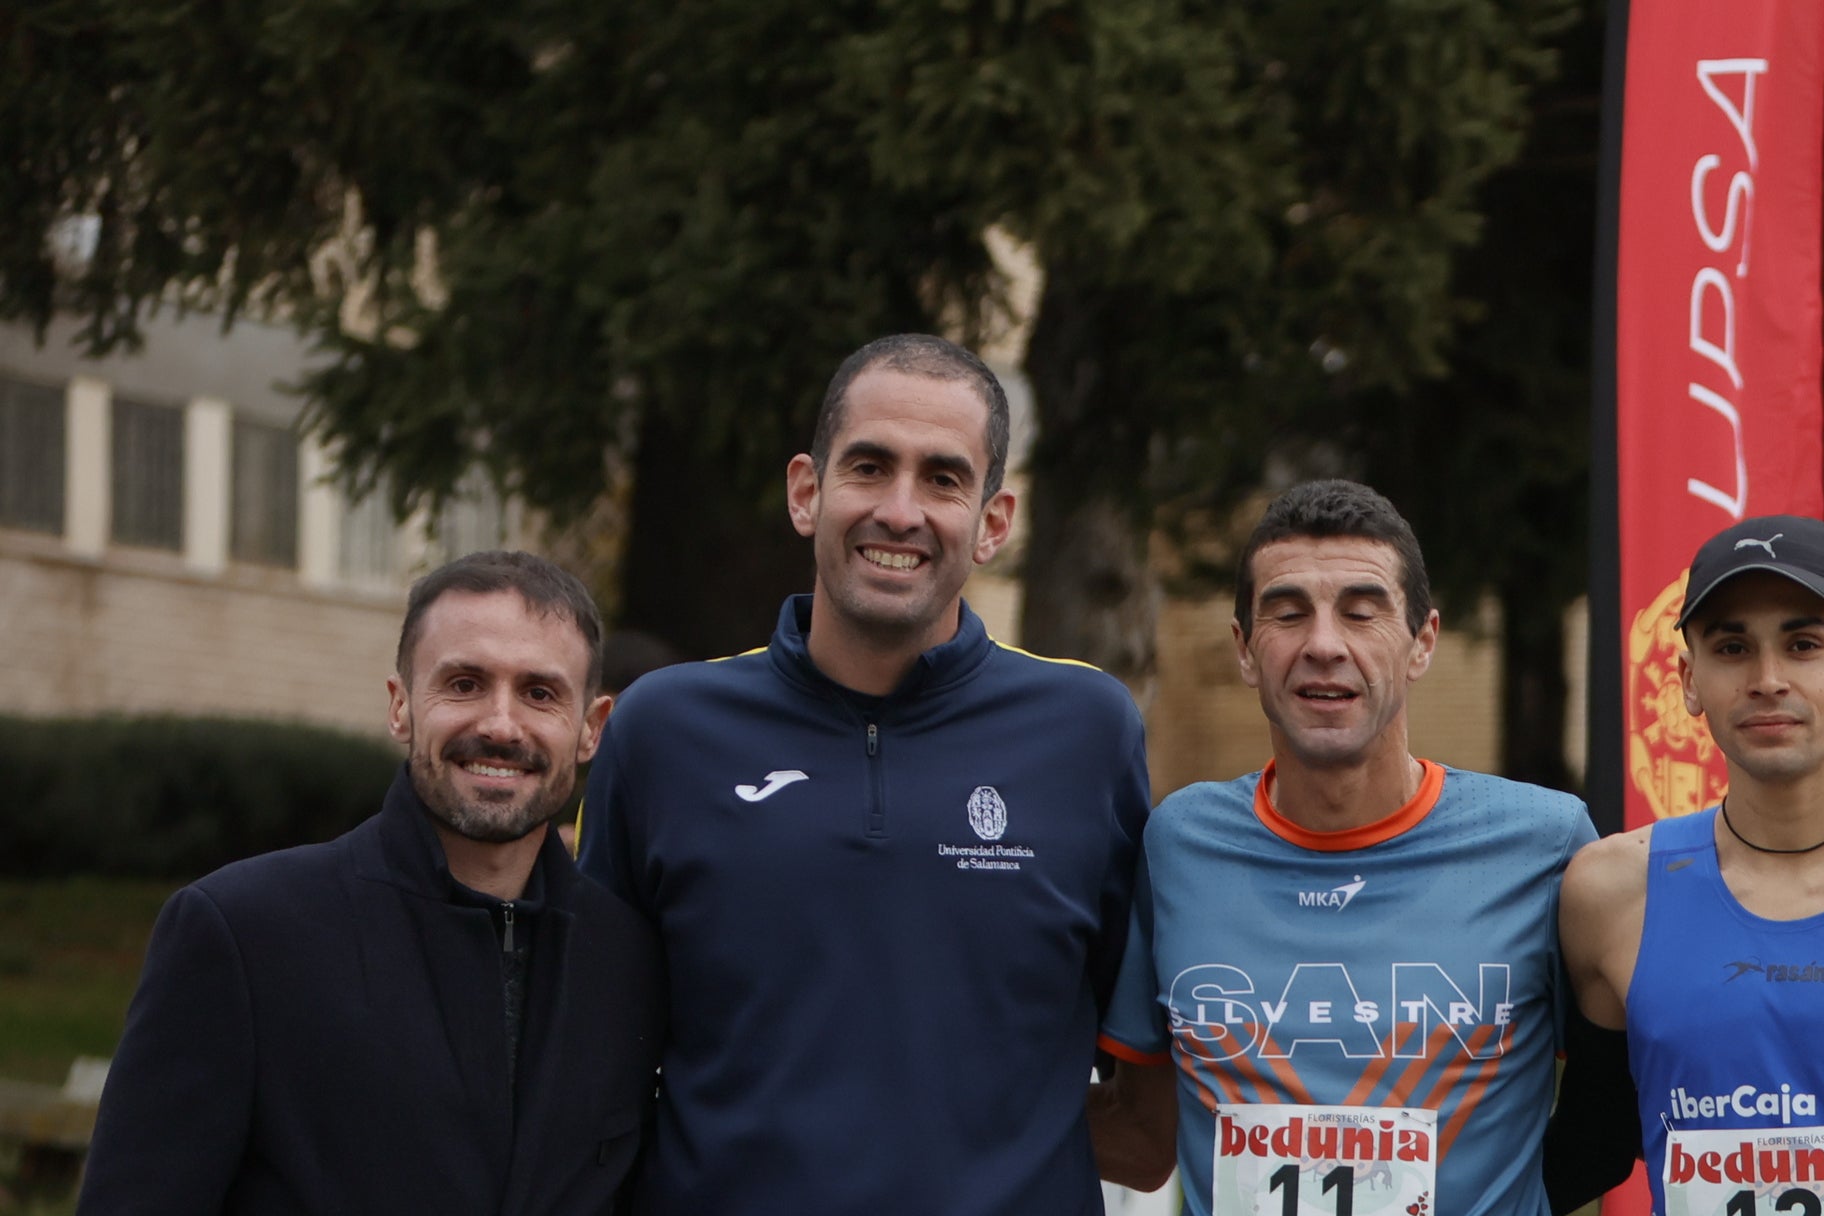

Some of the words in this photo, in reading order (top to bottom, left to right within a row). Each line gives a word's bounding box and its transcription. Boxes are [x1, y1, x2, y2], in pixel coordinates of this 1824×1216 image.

[1687, 58, 1769, 520] UPSA
[938, 843, 995, 857] Universidad
[996, 844, 1035, 858] Pontificia
[956, 857, 969, 870] de
[970, 858, 1020, 870] Salamanca
[1298, 891, 1342, 907] MKA
[1168, 963, 1511, 1061] SAN
[1169, 1001, 1514, 1028] SILVESTRE
[1671, 1083, 1816, 1124] iberCaja
[1307, 1112, 1376, 1125] FLORISTERÍAS
[1220, 1116, 1430, 1162] bedunia
